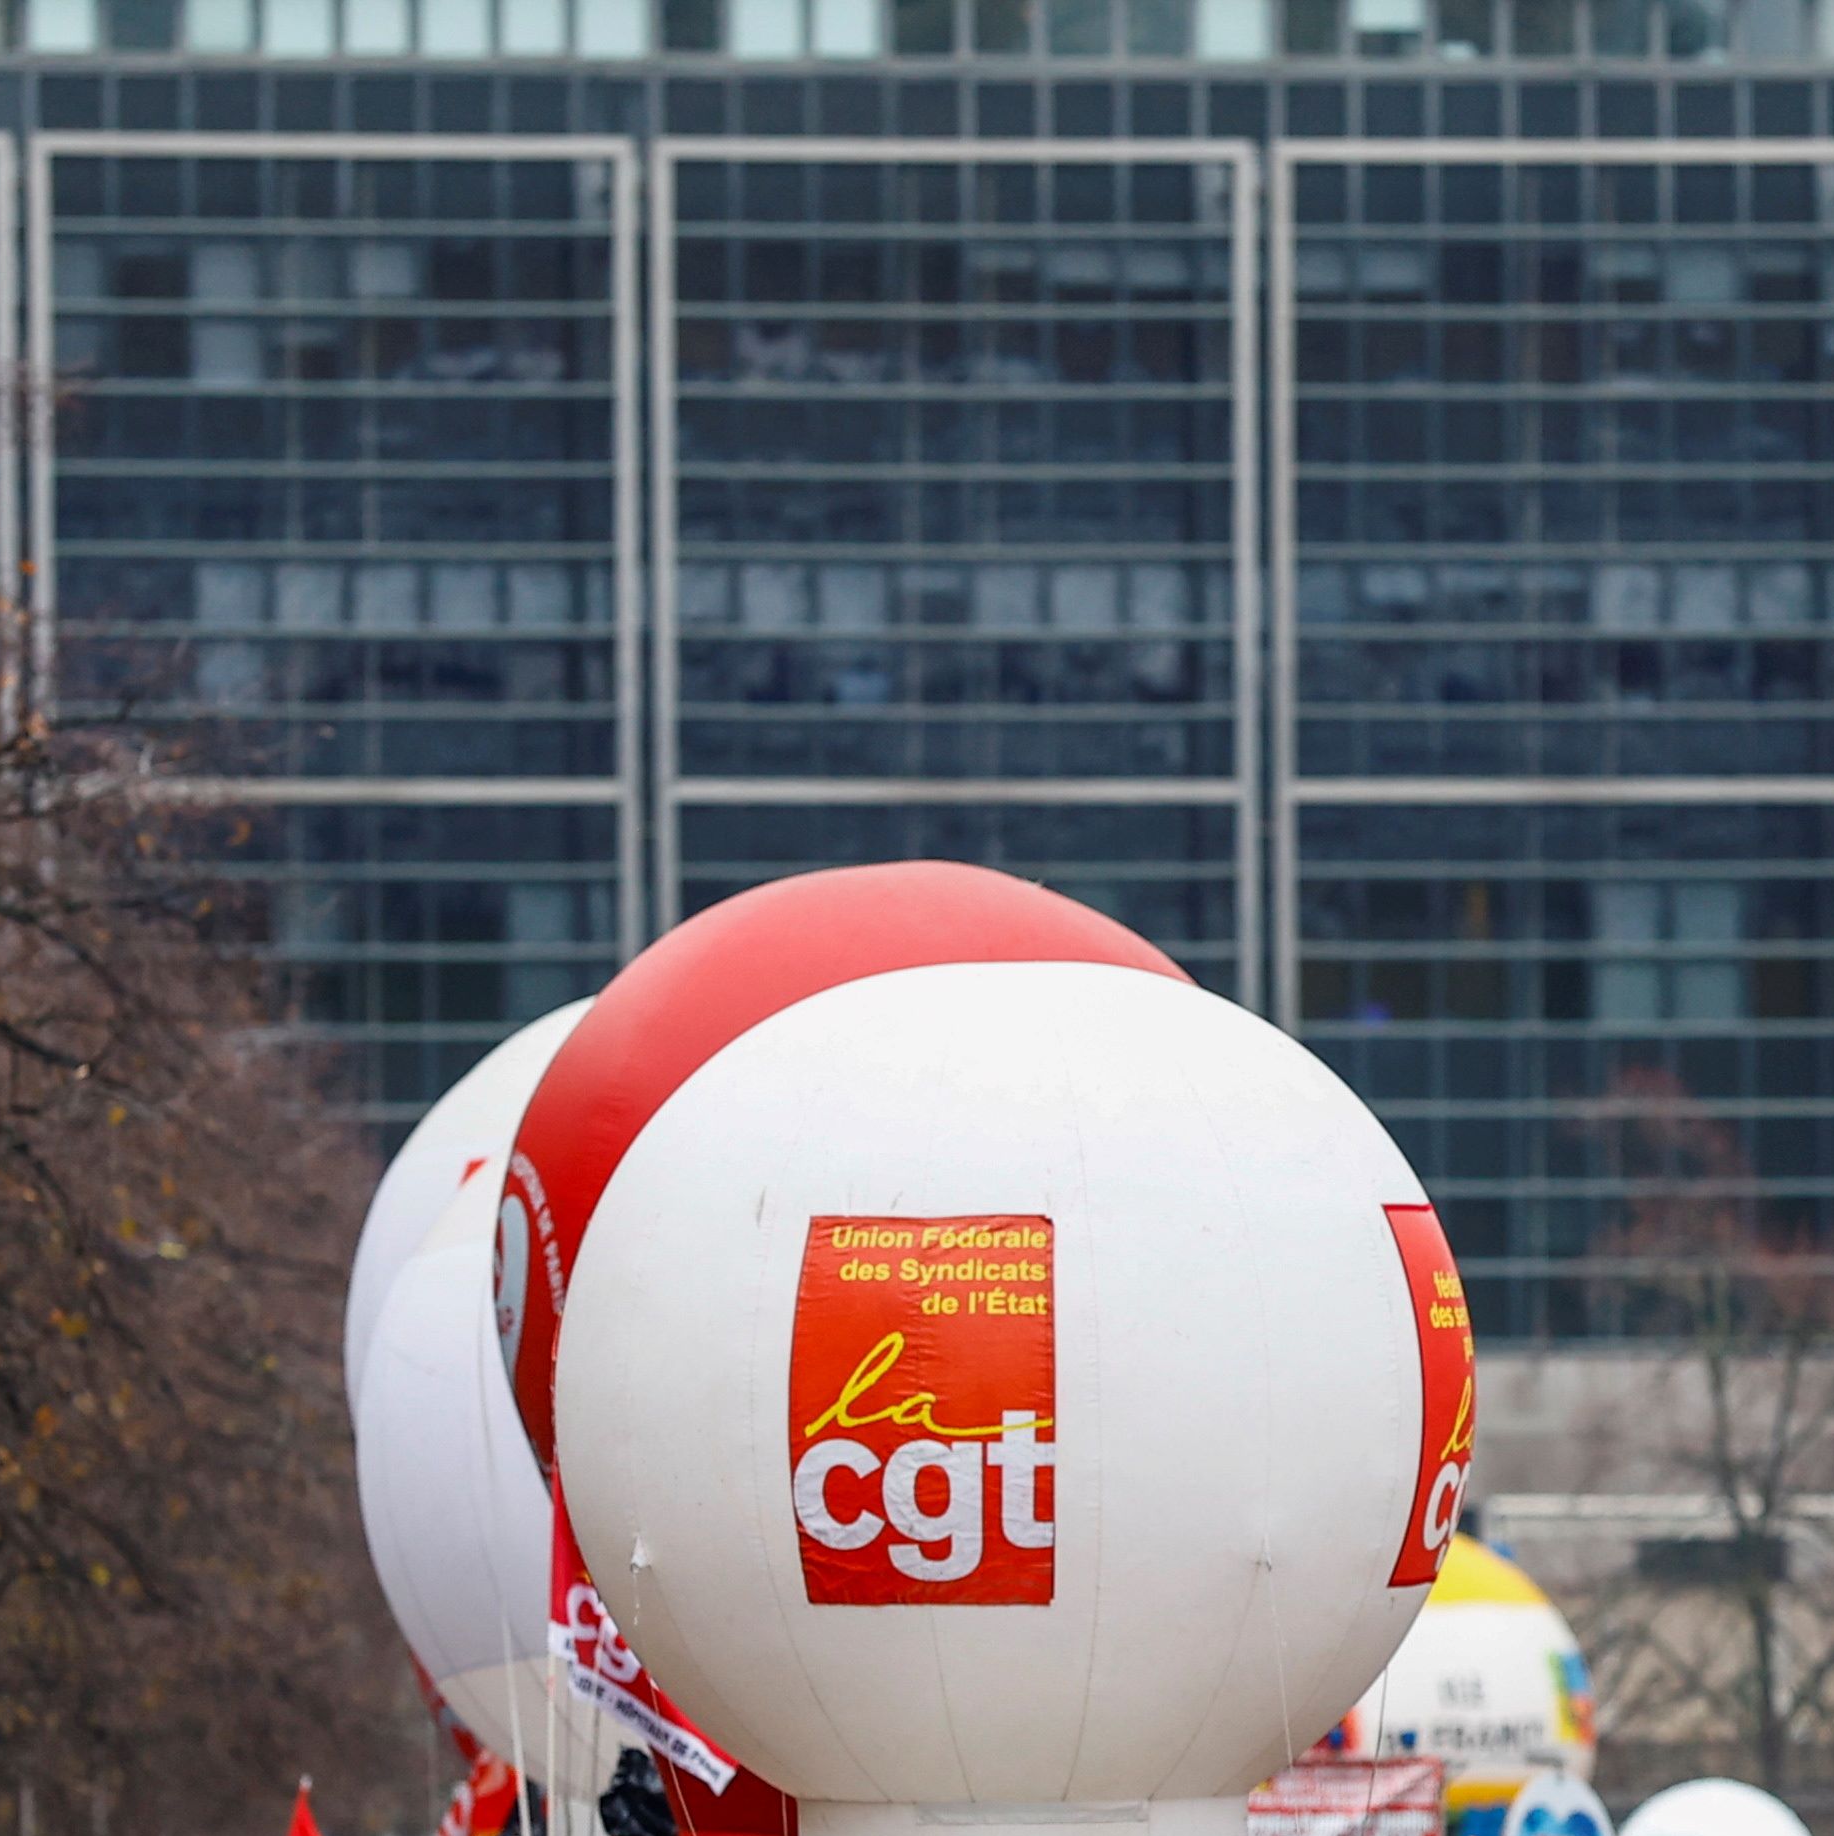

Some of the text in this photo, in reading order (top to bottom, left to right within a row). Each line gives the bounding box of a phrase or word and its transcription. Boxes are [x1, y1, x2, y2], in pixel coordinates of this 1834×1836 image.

[831, 1225, 1048, 1250] Union Fédérale
[839, 1259, 1047, 1287] des Syndicats
[921, 1288, 1048, 1315] de l'État
[804, 1331, 1053, 1438] la
[793, 1410, 1056, 1583] cgt
